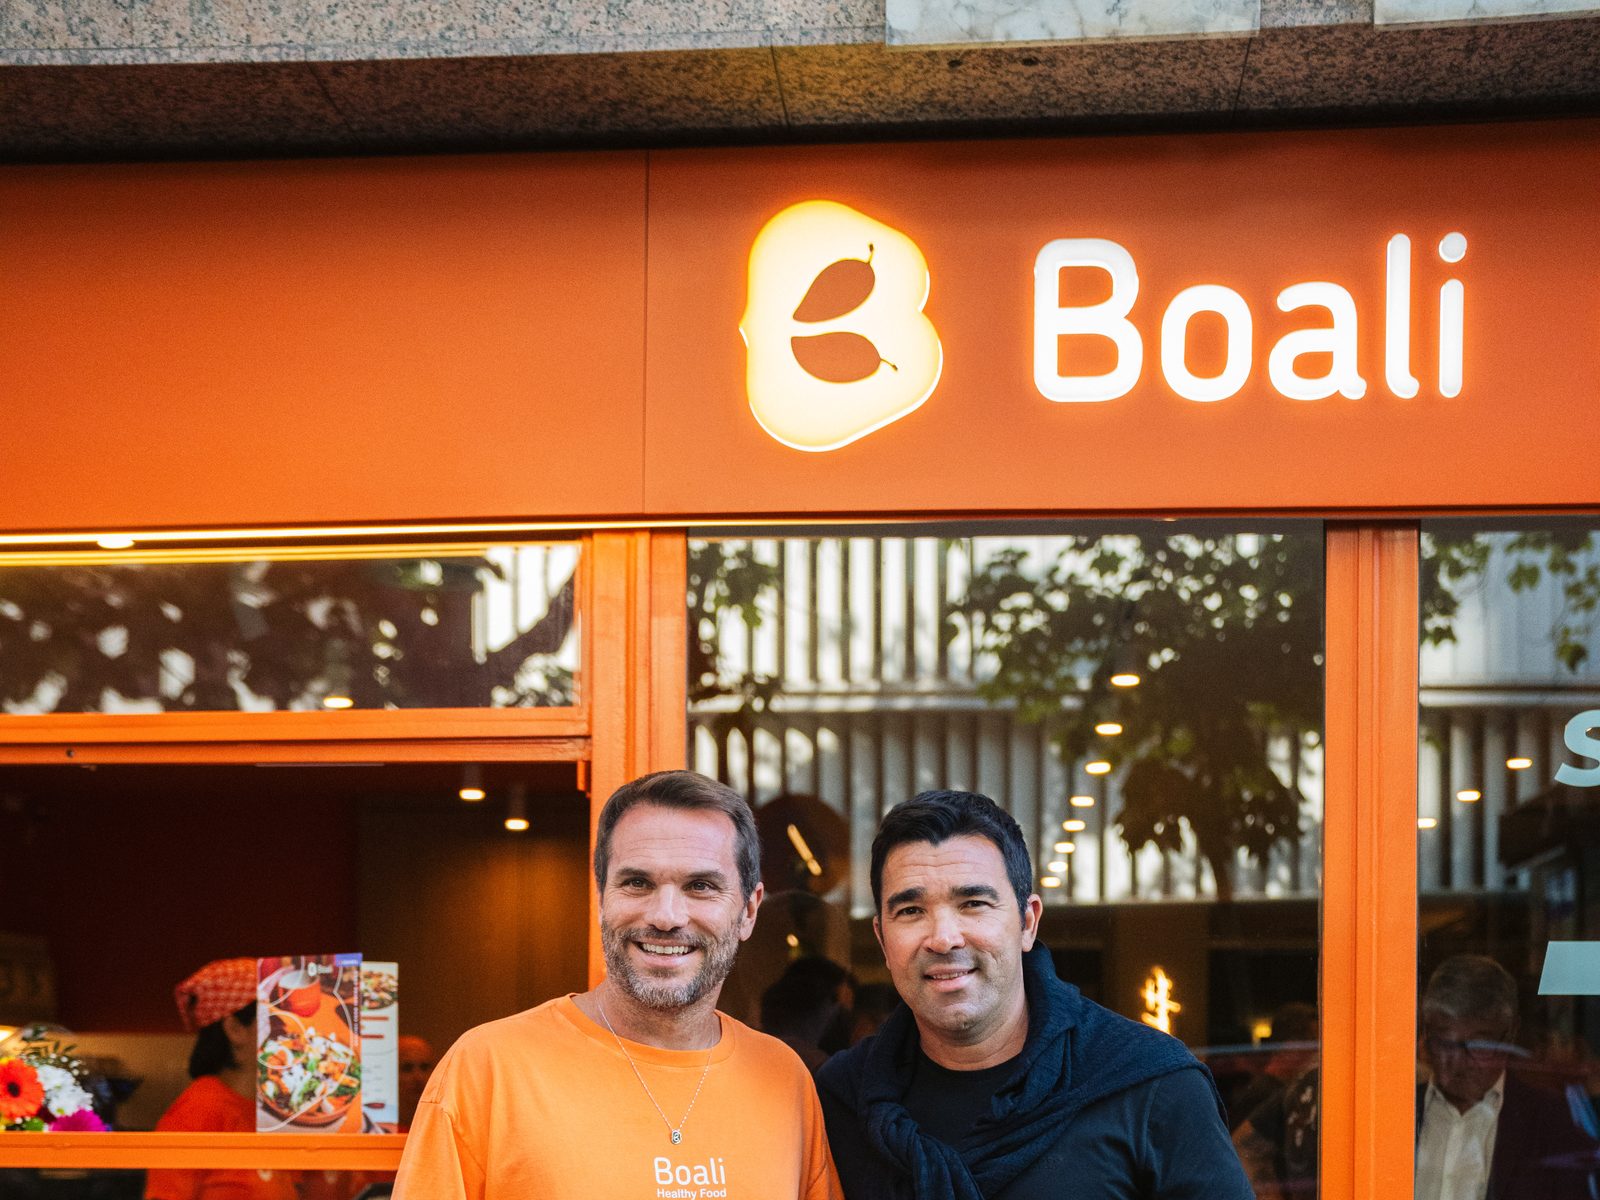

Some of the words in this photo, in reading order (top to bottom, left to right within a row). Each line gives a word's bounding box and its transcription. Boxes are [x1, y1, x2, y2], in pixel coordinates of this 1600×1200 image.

[1032, 231, 1467, 403] Boali
[653, 1156, 727, 1186] Boali
[656, 1188, 697, 1200] Healthy
[699, 1187, 727, 1199] Food
